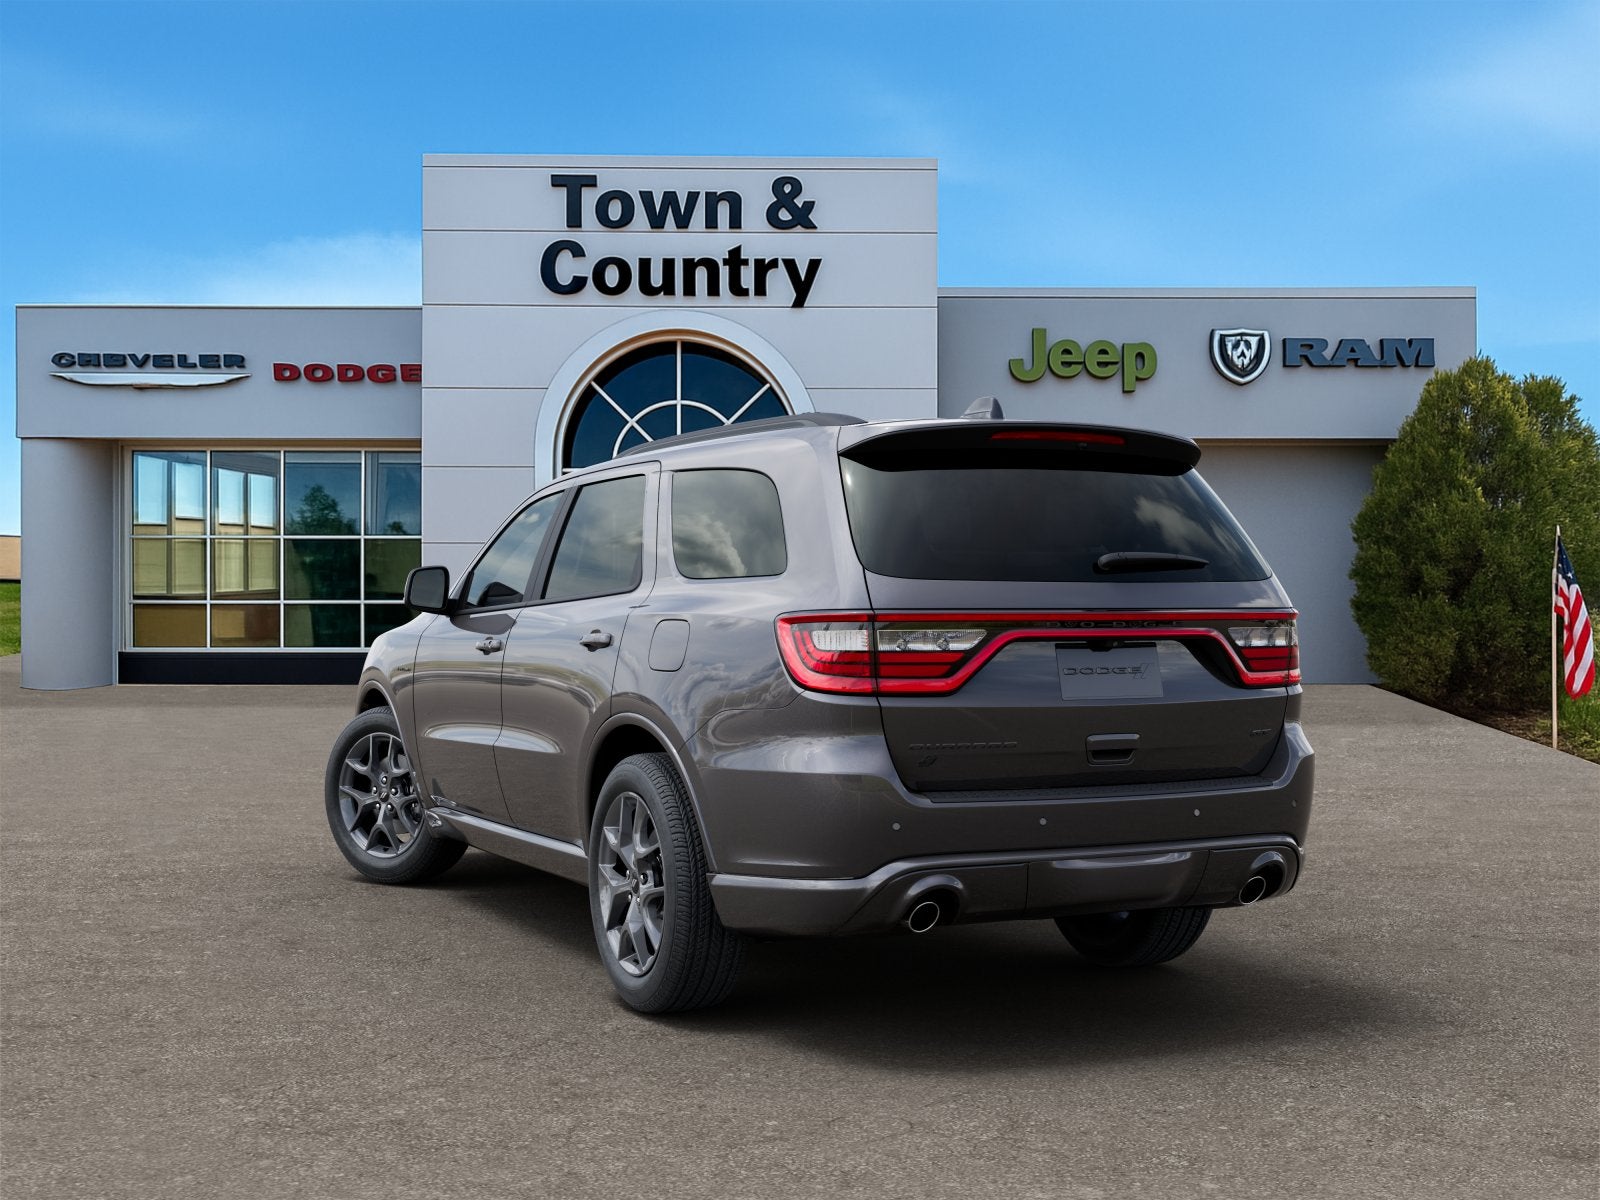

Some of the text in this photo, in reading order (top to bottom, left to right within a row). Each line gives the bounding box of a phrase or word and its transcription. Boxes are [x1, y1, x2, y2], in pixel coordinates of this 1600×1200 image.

[550, 174, 818, 230] Town &
[540, 239, 822, 308] Country
[272, 362, 422, 384] DODGE
[1009, 327, 1158, 392] Jeep
[1282, 337, 1435, 368] RAM
[1063, 666, 1143, 676] DODGE
